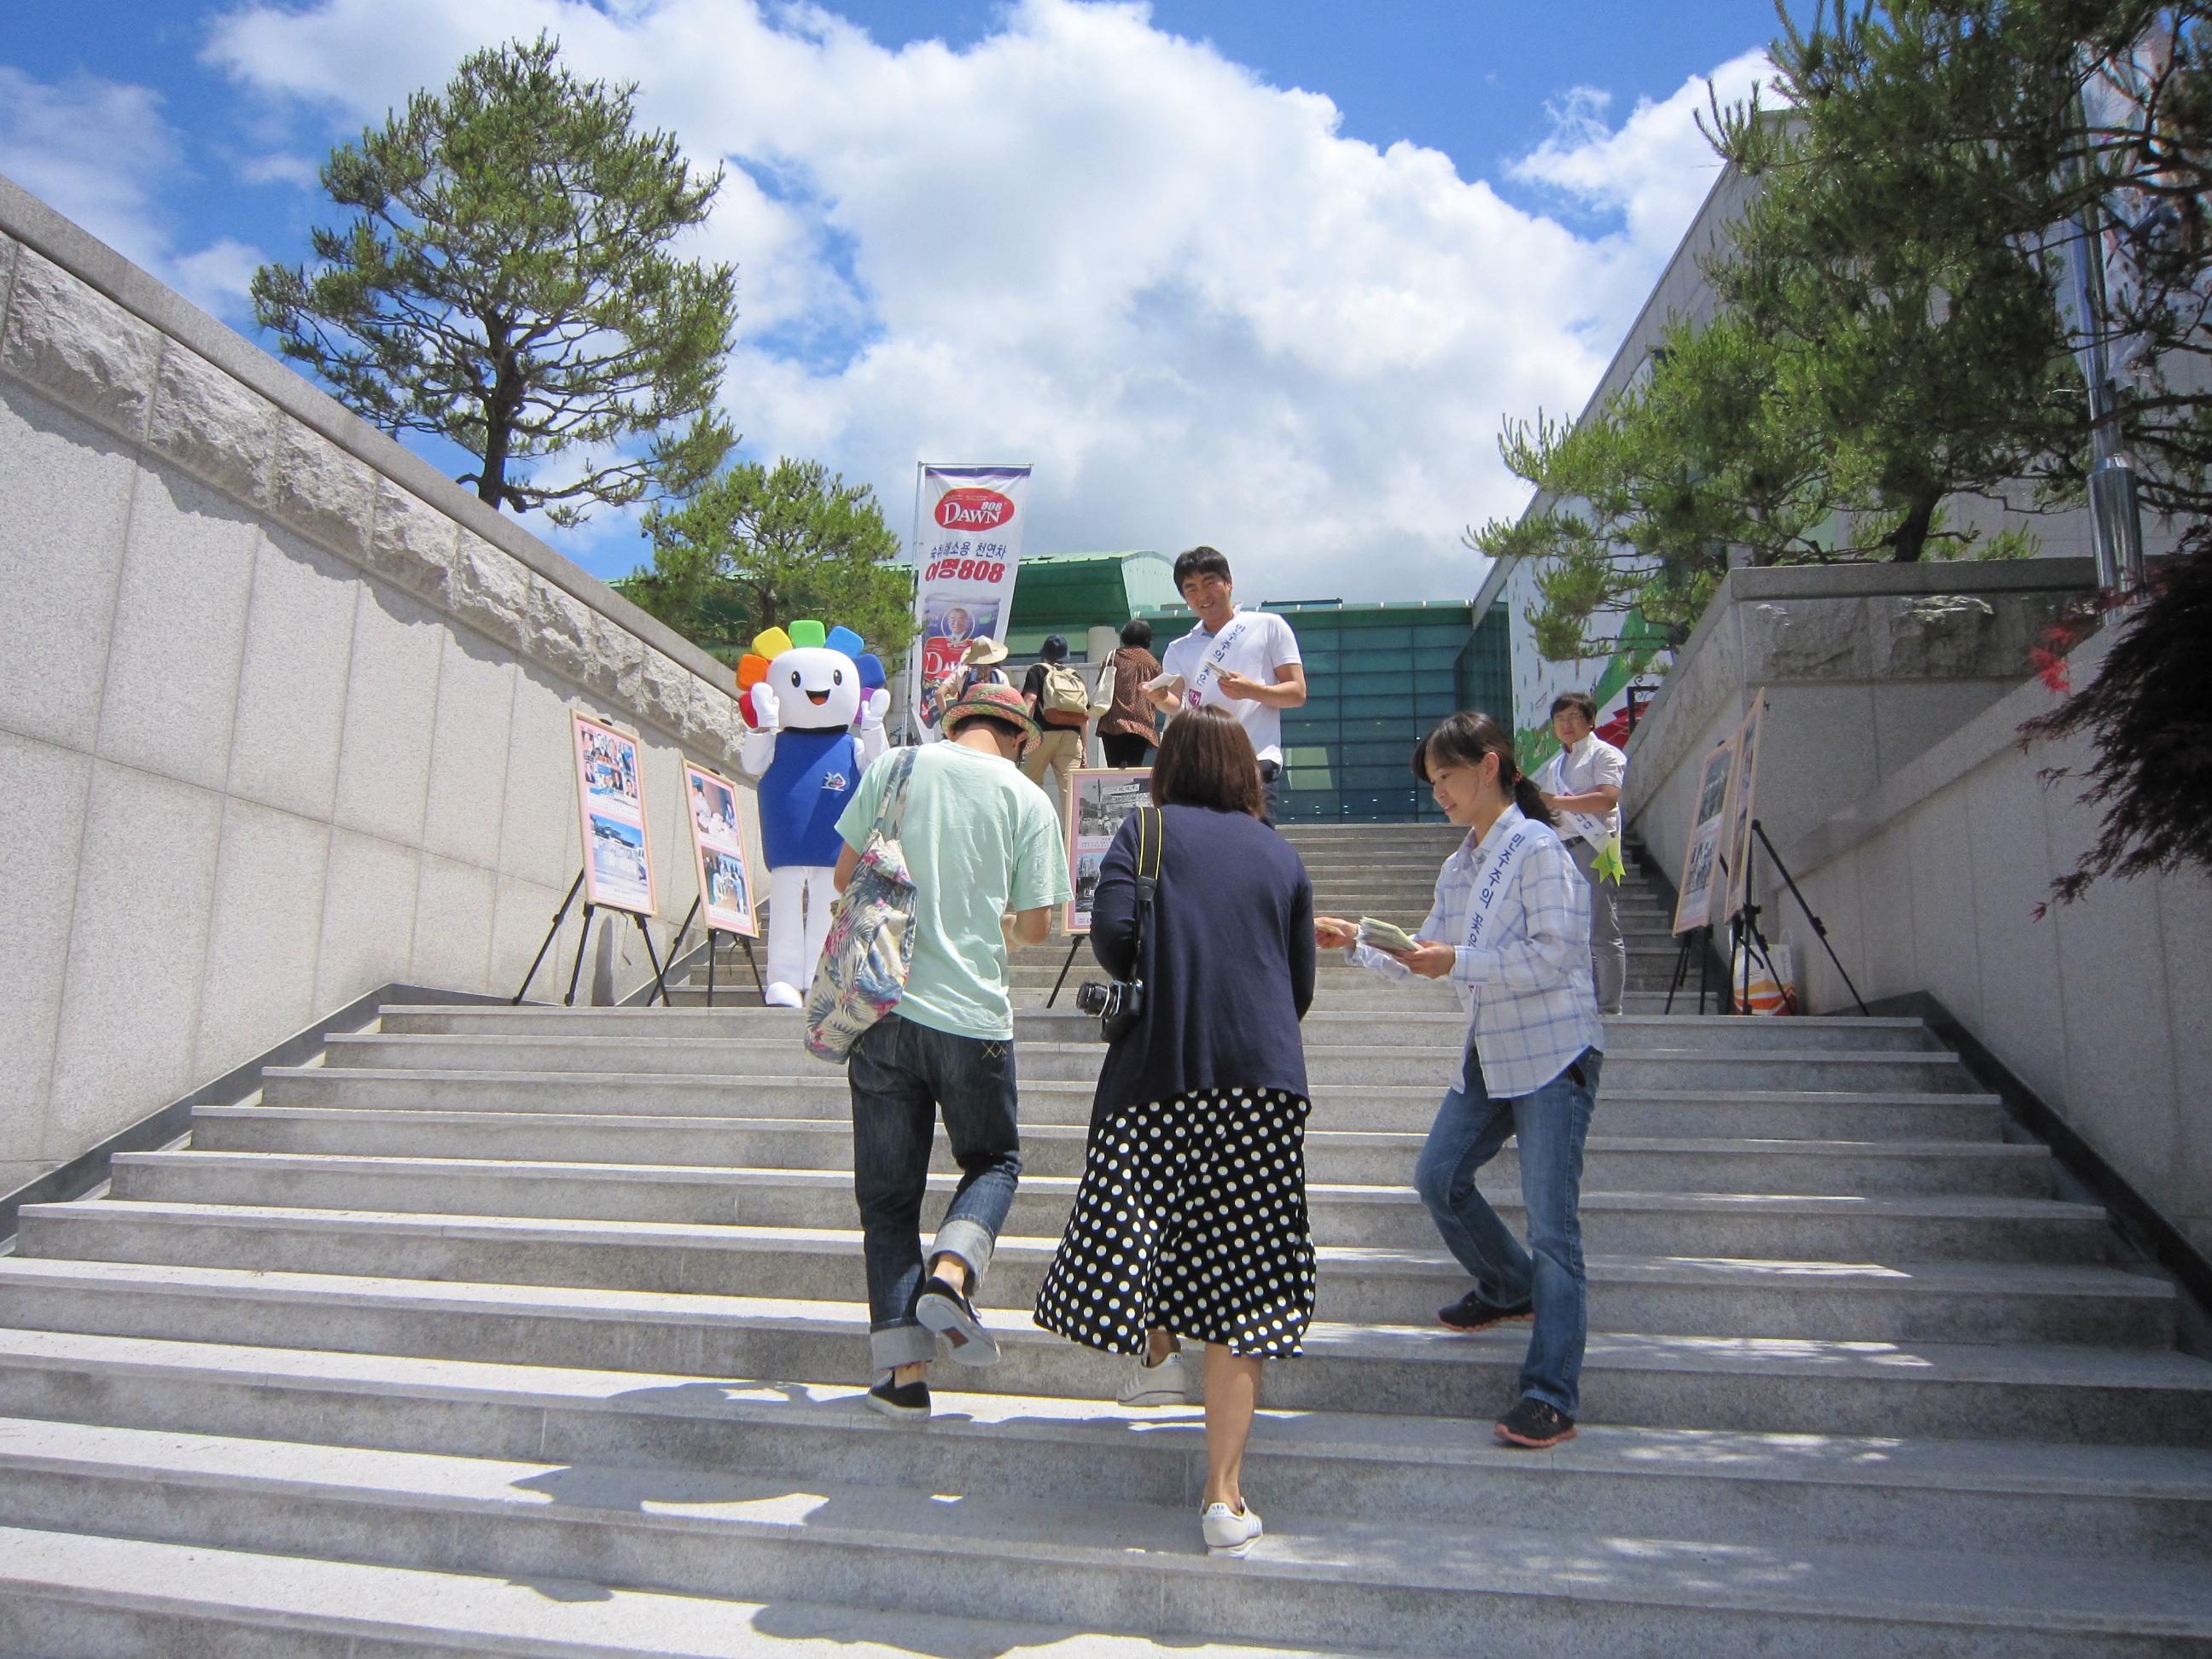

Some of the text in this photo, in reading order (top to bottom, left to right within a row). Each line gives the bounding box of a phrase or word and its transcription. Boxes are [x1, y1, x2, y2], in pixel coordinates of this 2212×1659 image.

[981, 501, 1003, 511] 808
[975, 542, 1006, 560] 천연차
[1213, 624, 1246, 663] 민주주의
[1479, 833, 1526, 909] 민주주의
